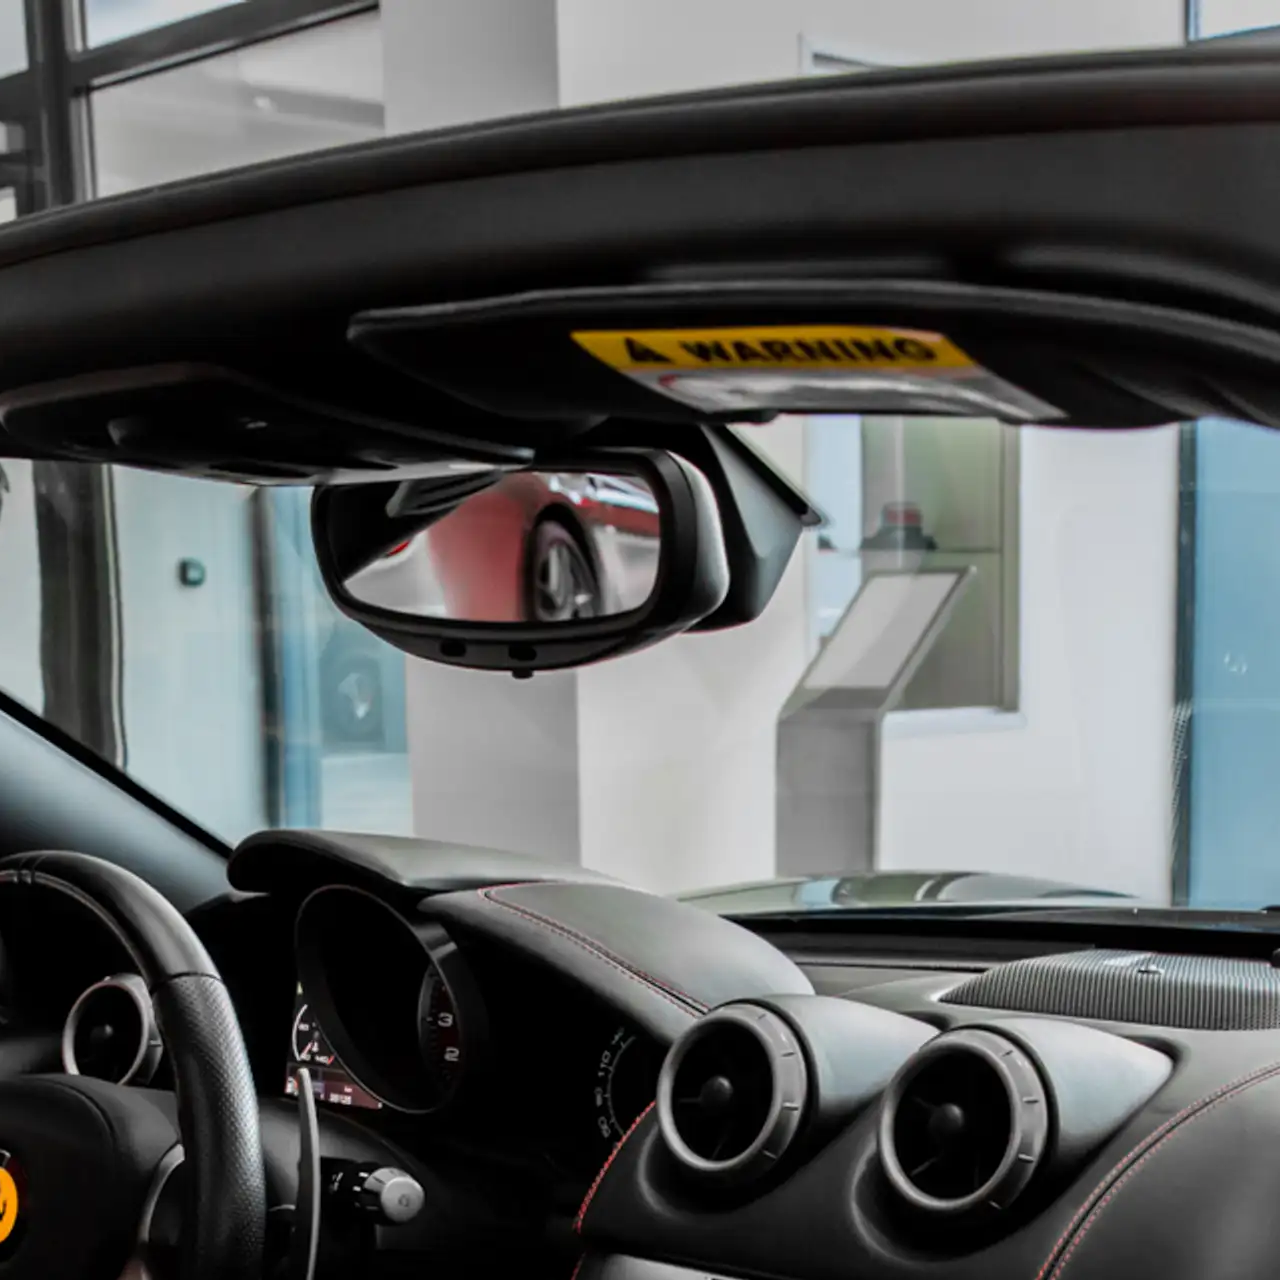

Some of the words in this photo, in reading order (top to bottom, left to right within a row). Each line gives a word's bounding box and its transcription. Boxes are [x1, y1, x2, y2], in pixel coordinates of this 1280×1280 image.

[678, 336, 938, 363] WARNING
[437, 1012, 454, 1028] 3
[443, 1047, 460, 1062] 2
